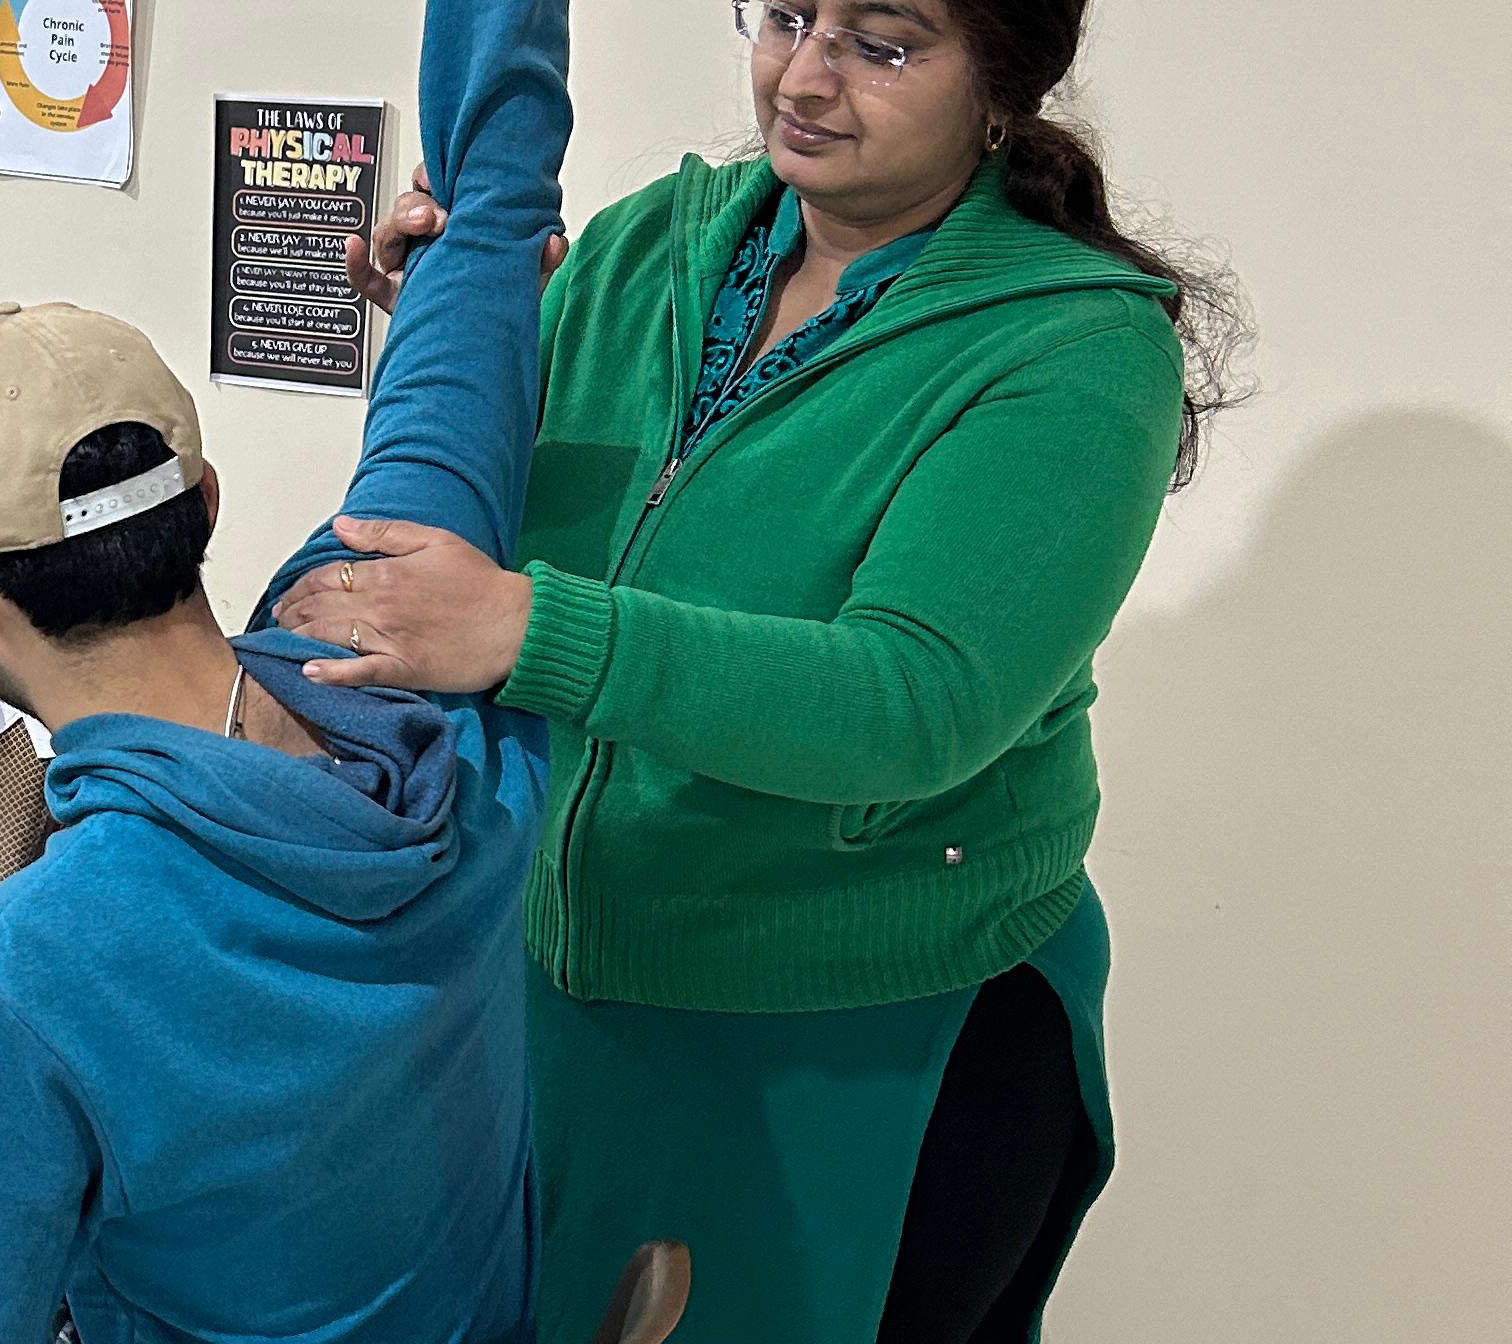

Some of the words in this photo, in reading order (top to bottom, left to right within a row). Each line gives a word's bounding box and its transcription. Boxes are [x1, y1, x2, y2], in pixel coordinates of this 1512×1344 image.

[43, 17, 85, 32] Chronic
[51, 34, 74, 47] Pain
[49, 50, 78, 64] Cycle
[257, 109, 281, 127] THE
[286, 110, 324, 130] LAWS
[328, 113, 344, 130] OF
[230, 127, 374, 165] PHYSICAL
[241, 159, 362, 192] THERAPY
[245, 195, 277, 207] NEVER
[278, 197, 297, 209] SAY
[298, 198, 321, 210] YOU
[239, 207, 266, 217] because
[248, 232, 280, 244] NEVER
[281, 235, 301, 246] SAY
[238, 243, 268, 254] because
[269, 246, 288, 256] we'll
[289, 248, 304, 258] just
[304, 250, 327, 259] make
[308, 271, 319, 280] TO
[320, 272, 332, 281] GO
[237, 276, 268, 287] because
[269, 280, 291, 290] you'll
[292, 282, 307, 292] just
[308, 283, 325, 294] stay
[326, 283, 352, 297] longer
[251, 302, 282, 314] NEVER
[283, 304, 305, 317] LOSE
[305, 306, 341, 319] COUNT
[233, 311, 264, 323] because
[315, 321, 332, 329] one
[332, 322, 353, 334] again
[260, 339, 291, 351] NEVER
[291, 342, 314, 354] GIVE
[314, 344, 328, 355] UP
[233, 346, 266, 360] because
[266, 352, 280, 361] we
[282, 353, 296, 363] will
[297, 355, 321, 365] never
[322, 356, 334, 366] let
[334, 360, 353, 370] you
